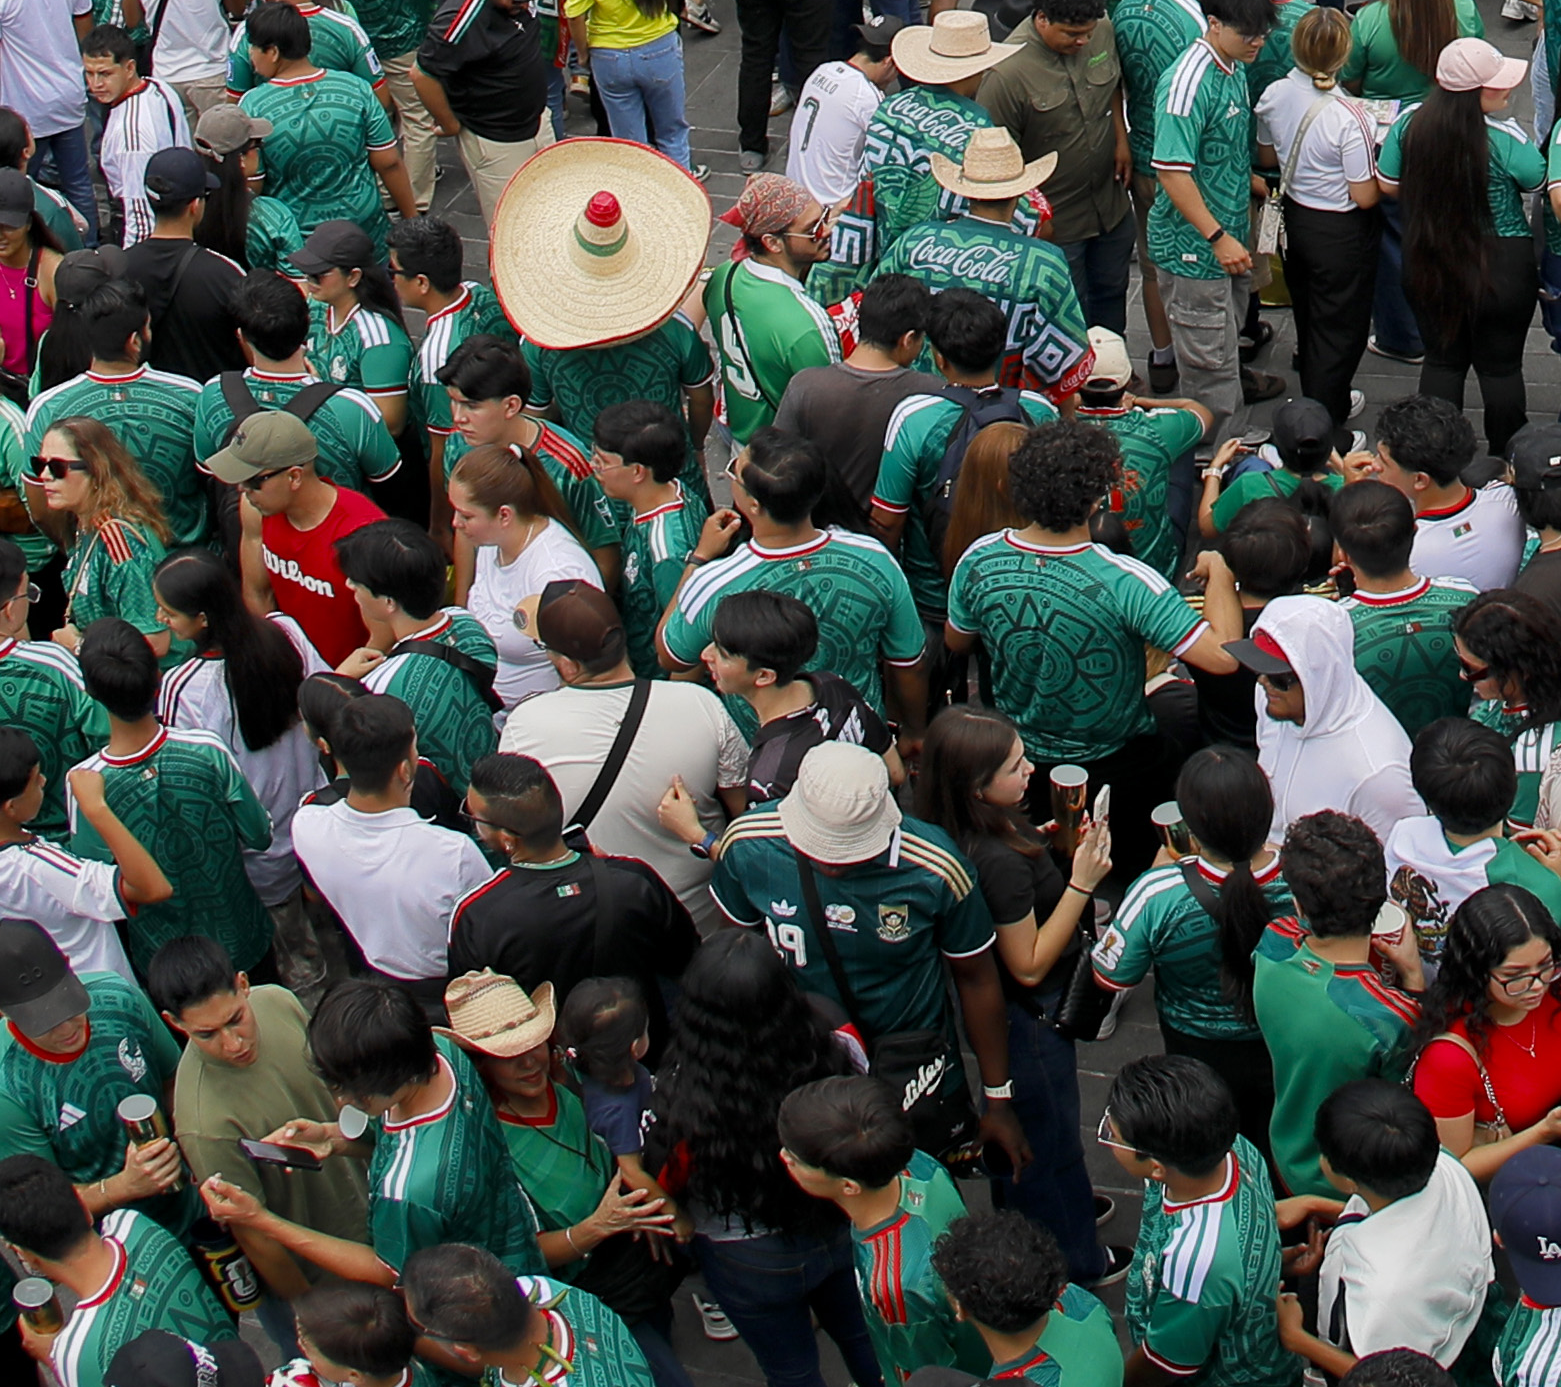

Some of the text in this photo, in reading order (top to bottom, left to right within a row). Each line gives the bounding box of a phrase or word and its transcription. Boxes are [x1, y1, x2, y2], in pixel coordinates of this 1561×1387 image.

[802, 95, 821, 152] 7
[262, 543, 335, 598] Wilson
[902, 1056, 945, 1113] didas
